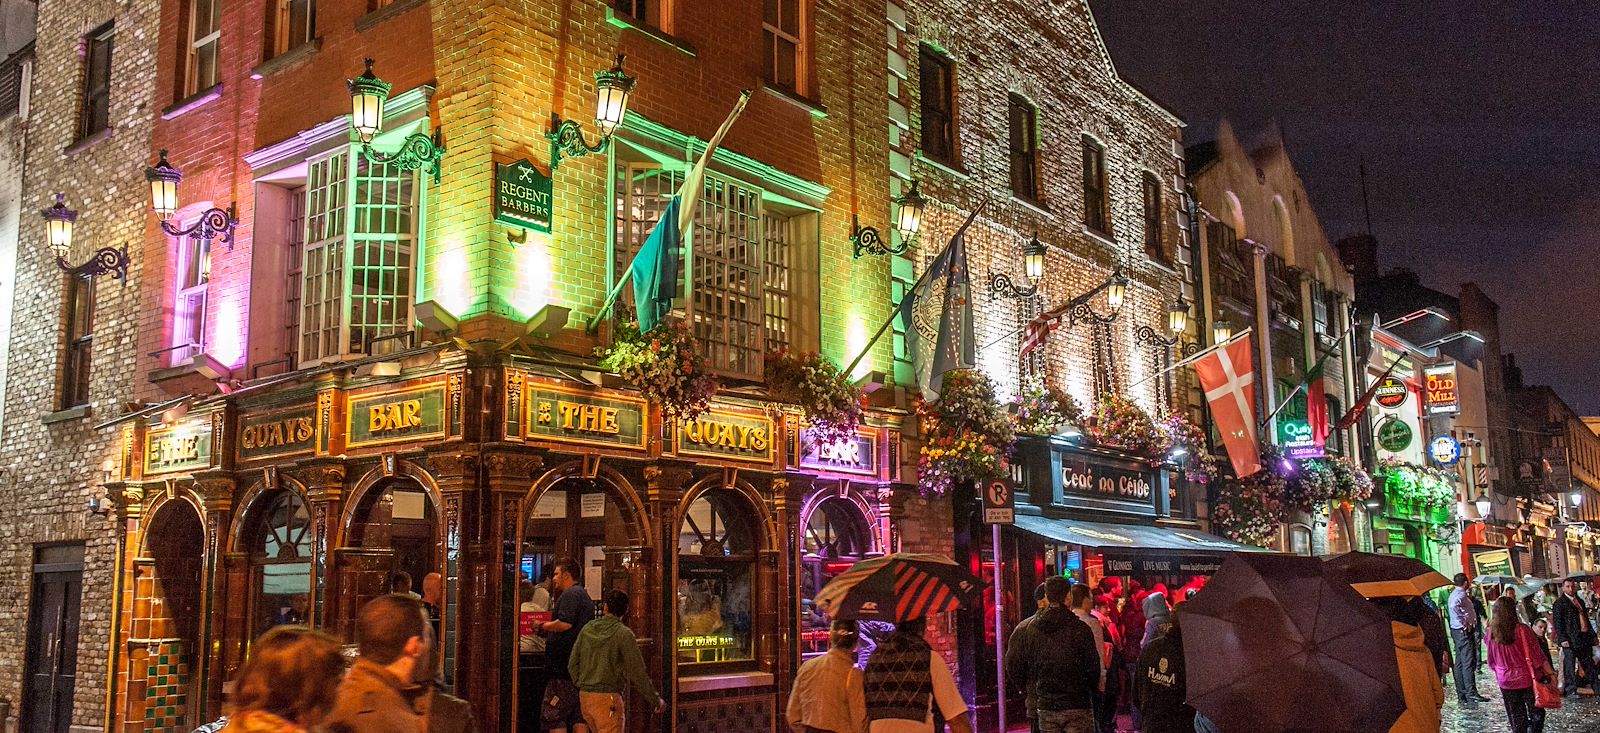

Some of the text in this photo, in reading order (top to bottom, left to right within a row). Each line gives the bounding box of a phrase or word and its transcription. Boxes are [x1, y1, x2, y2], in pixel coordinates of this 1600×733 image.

[501, 180, 549, 204] REGENT
[501, 196, 549, 216] BARBERS
[1427, 379, 1455, 391] OLD
[1427, 391, 1456, 402] MILL
[160, 433, 199, 463] THE
[242, 416, 314, 449] QUAYS
[369, 399, 422, 433] BAR
[557, 400, 620, 434] THE
[685, 419, 767, 451] QUAYS
[1099, 476, 1116, 493] na
[678, 637, 694, 647] THE
